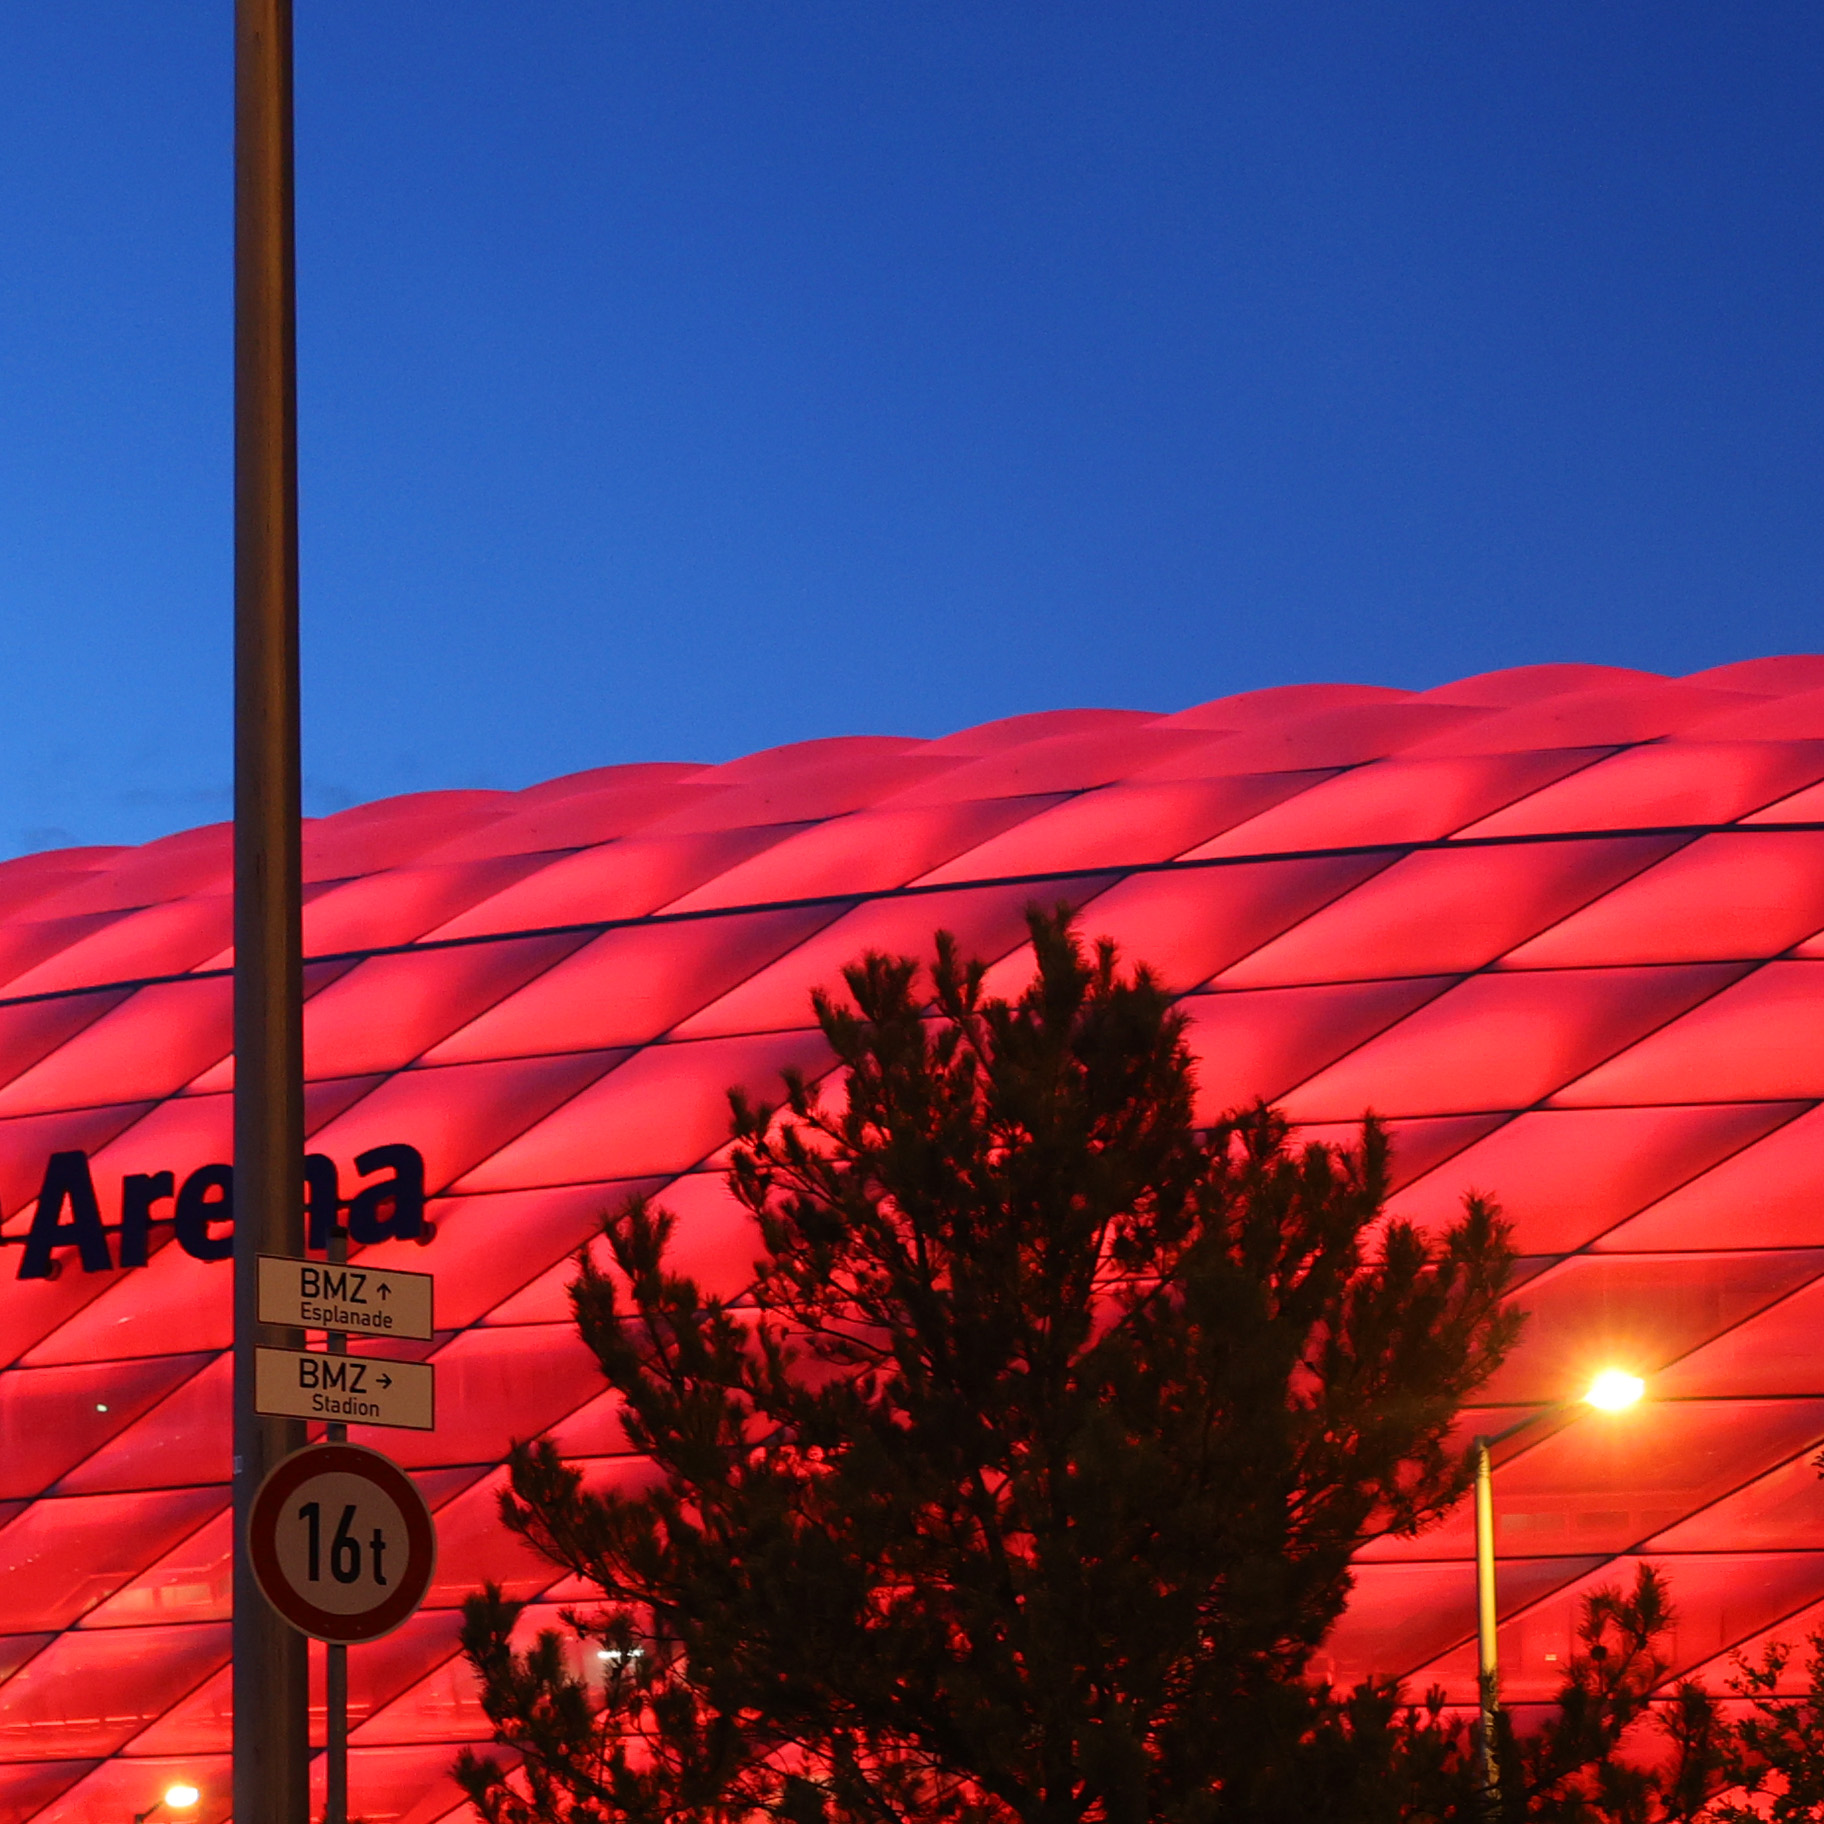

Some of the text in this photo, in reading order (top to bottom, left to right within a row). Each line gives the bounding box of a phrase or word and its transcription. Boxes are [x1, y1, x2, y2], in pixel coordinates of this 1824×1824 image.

[300, 1267, 368, 1304] BMZ
[300, 1302, 394, 1329] Esplanade
[299, 1358, 367, 1394] BMZ
[312, 1394, 381, 1417] Stadion
